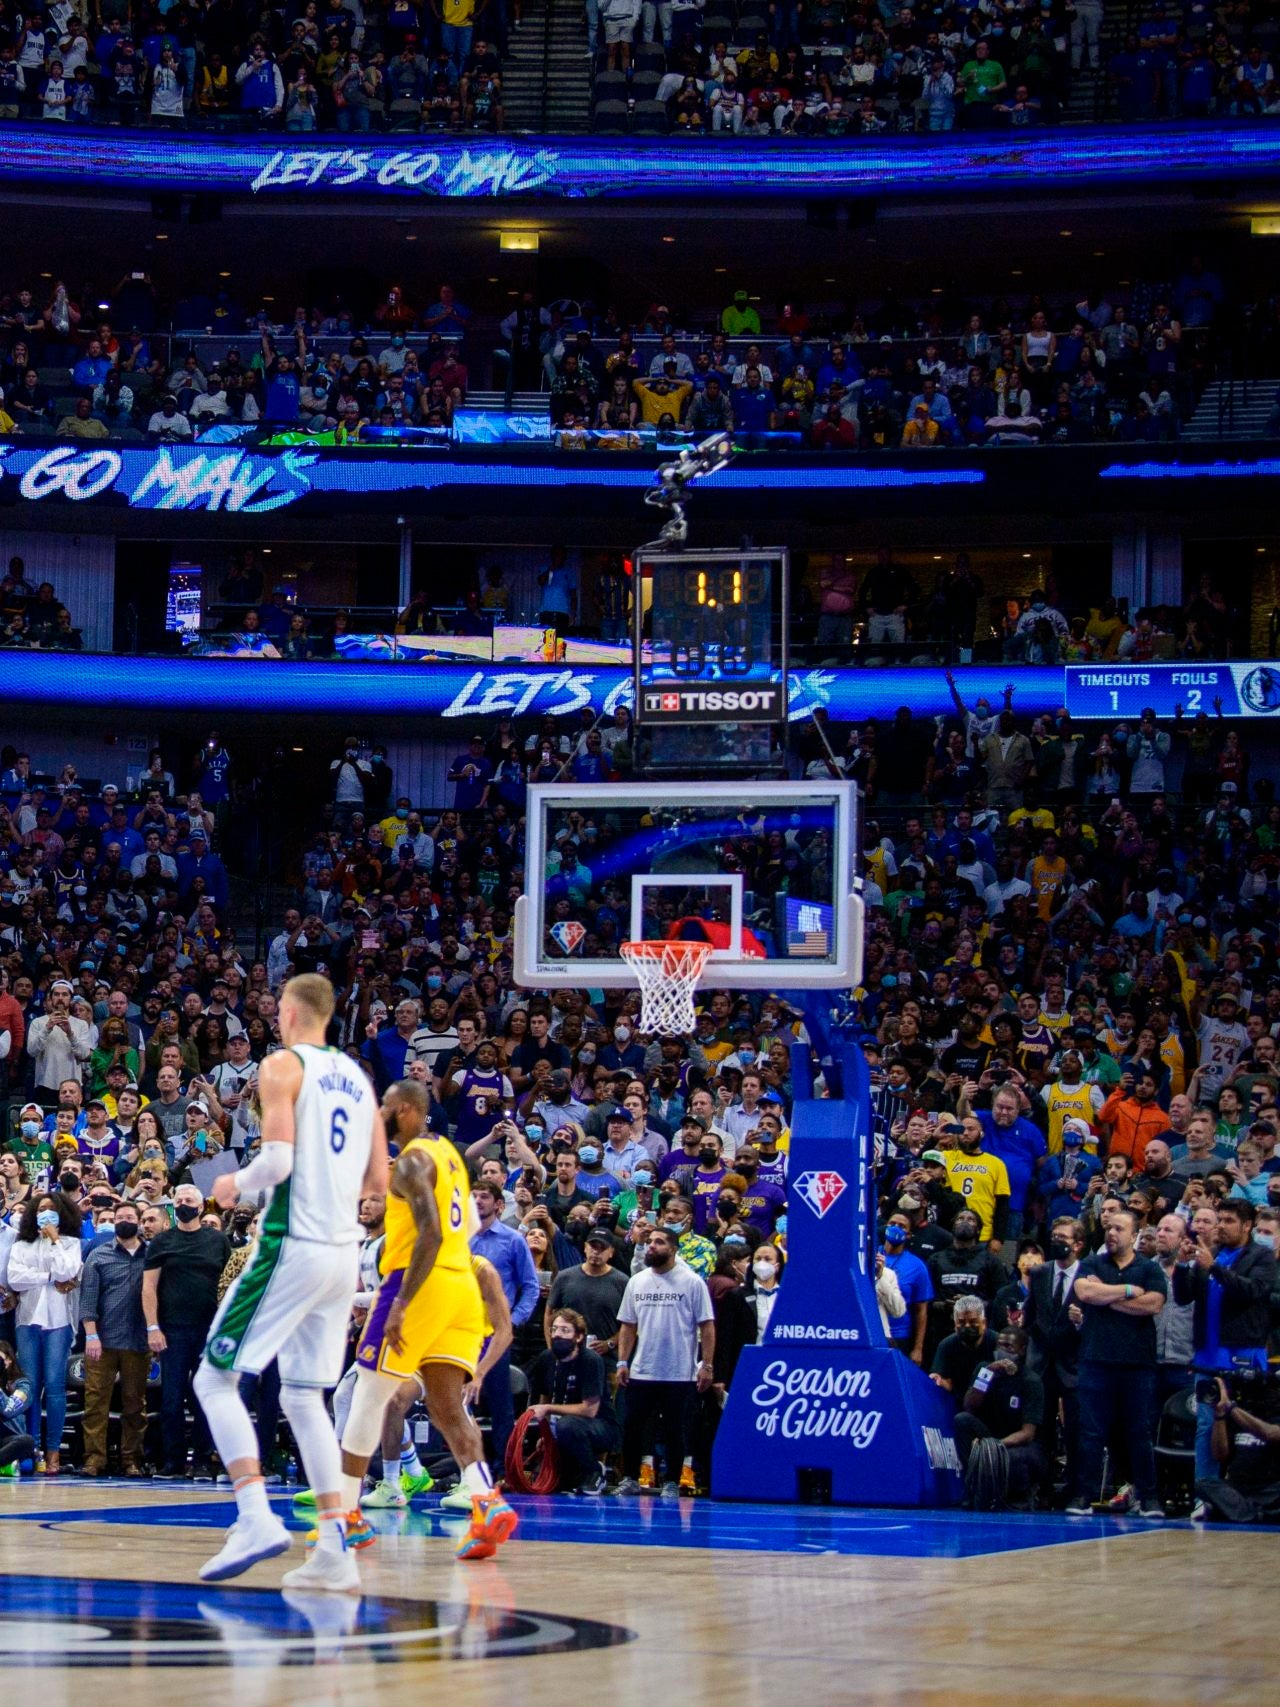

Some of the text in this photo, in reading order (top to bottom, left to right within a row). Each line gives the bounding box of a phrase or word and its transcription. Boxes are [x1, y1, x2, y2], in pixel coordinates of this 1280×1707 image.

[251, 148, 560, 198] LET'S GO MAVS
[20, 445, 122, 501] GO
[129, 445, 320, 513] MAVS
[1079, 672, 1218, 687] TIMEOUTS FOULS
[441, 671, 596, 718] LET'S
[686, 691, 775, 711] TISSOT
[1108, 689, 1202, 711] 1 2
[130, 739, 148, 749] 123
[214, 769, 223, 782] 5
[481, 884, 494, 895] 77
[1040, 881, 1058, 895] 24
[1210, 1033, 1242, 1048] LAKERS
[1212, 1045, 1234, 1064] 24
[474, 1096, 488, 1116] 8
[1051, 1099, 1084, 1112] LAKERS
[330, 1106, 349, 1154] 6
[951, 1162, 989, 1176] LAKERS
[824, 1178, 836, 1194] 75
[961, 1177, 974, 1197] 6
[451, 1187, 463, 1231] 6
[940, 1273, 979, 1287] ESPN
[635, 1293, 685, 1303] BURBERRY
[773, 1325, 859, 1341] #NBACares
[751, 1360, 872, 1408] Season
[756, 1398, 883, 1450] of Giving
